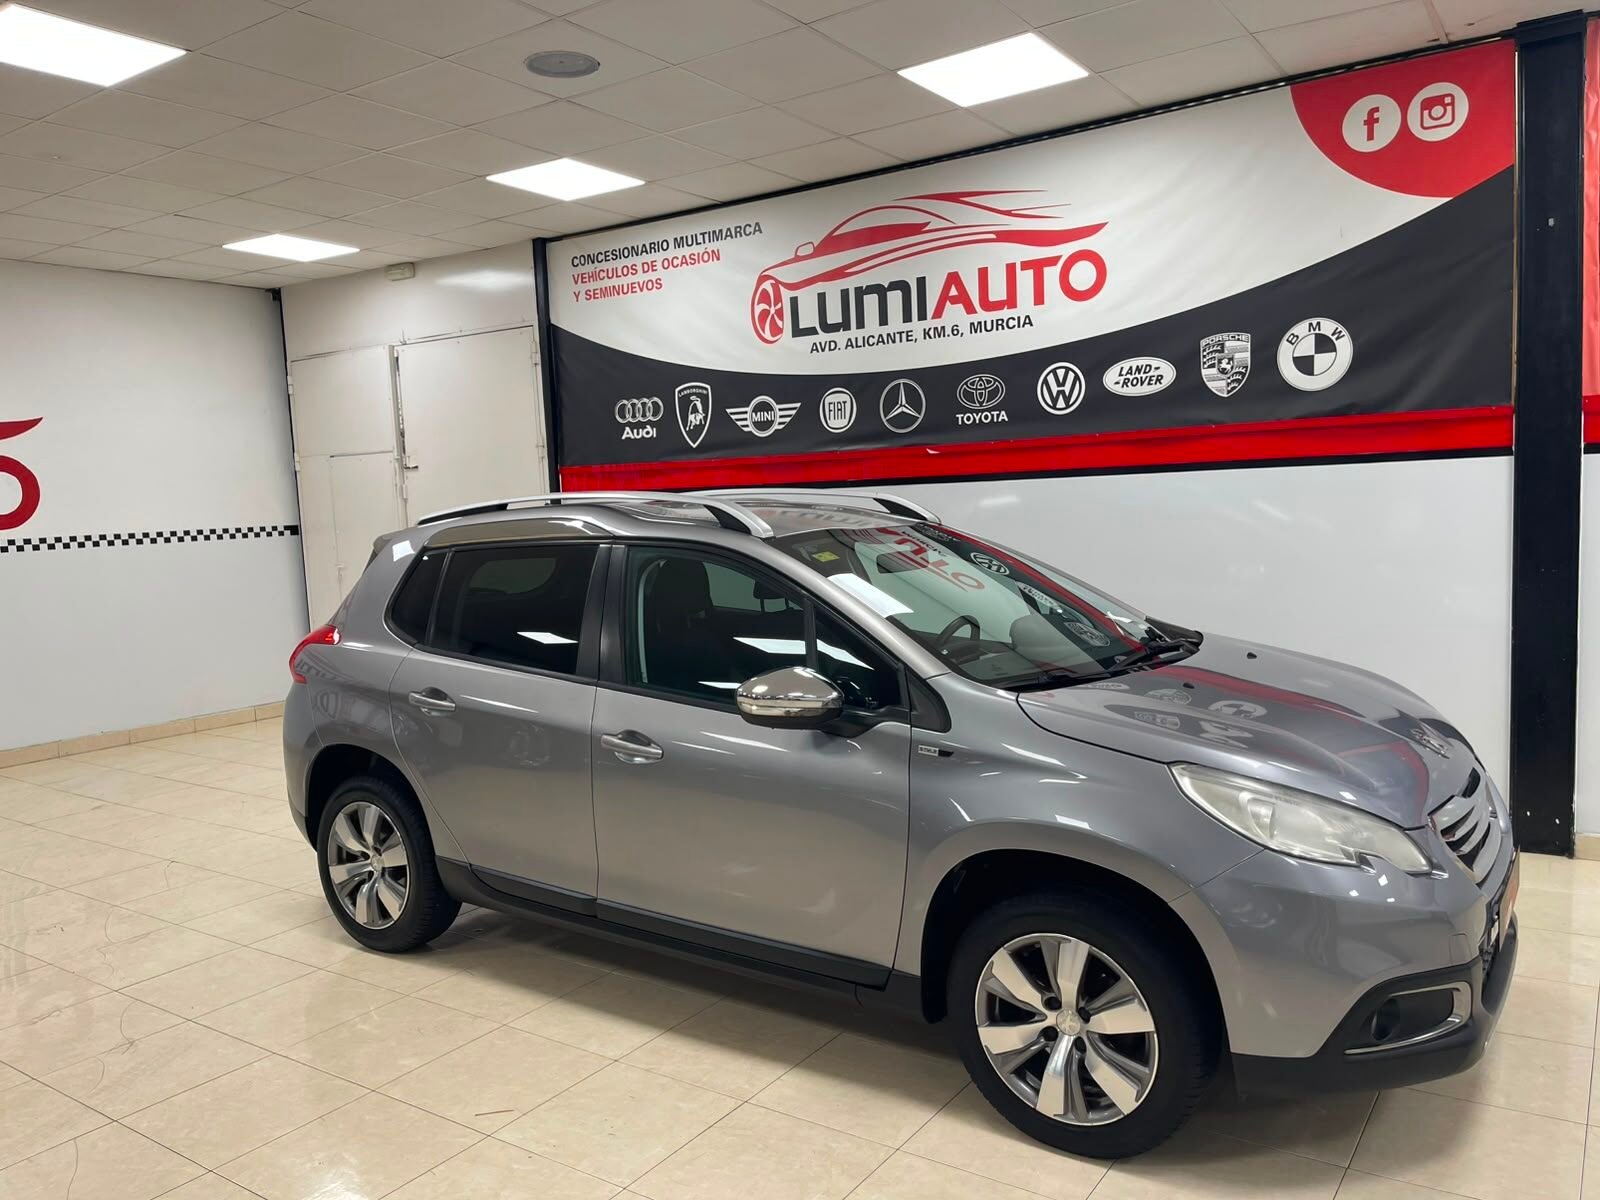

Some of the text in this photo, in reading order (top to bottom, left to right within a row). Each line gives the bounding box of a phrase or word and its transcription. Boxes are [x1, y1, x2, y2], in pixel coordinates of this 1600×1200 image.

[571, 221, 763, 268] CONCESIONARIO MULTIMARCA
[572, 247, 721, 285] VEHÍCULOS DE OCASIÓN
[573, 277, 663, 302] Y SEMINUEVOS
[810, 314, 1034, 354] AVD. ALICANTE, KM.6, MURCIA
[1202, 334, 1249, 346] PORSCHE
[1285, 321, 1345, 346] BMW
[752, 412, 775, 422] MINI
[828, 400, 848, 420] FIAT
[956, 410, 1009, 425] TOYOTA
[621, 425, 657, 440] Audi
